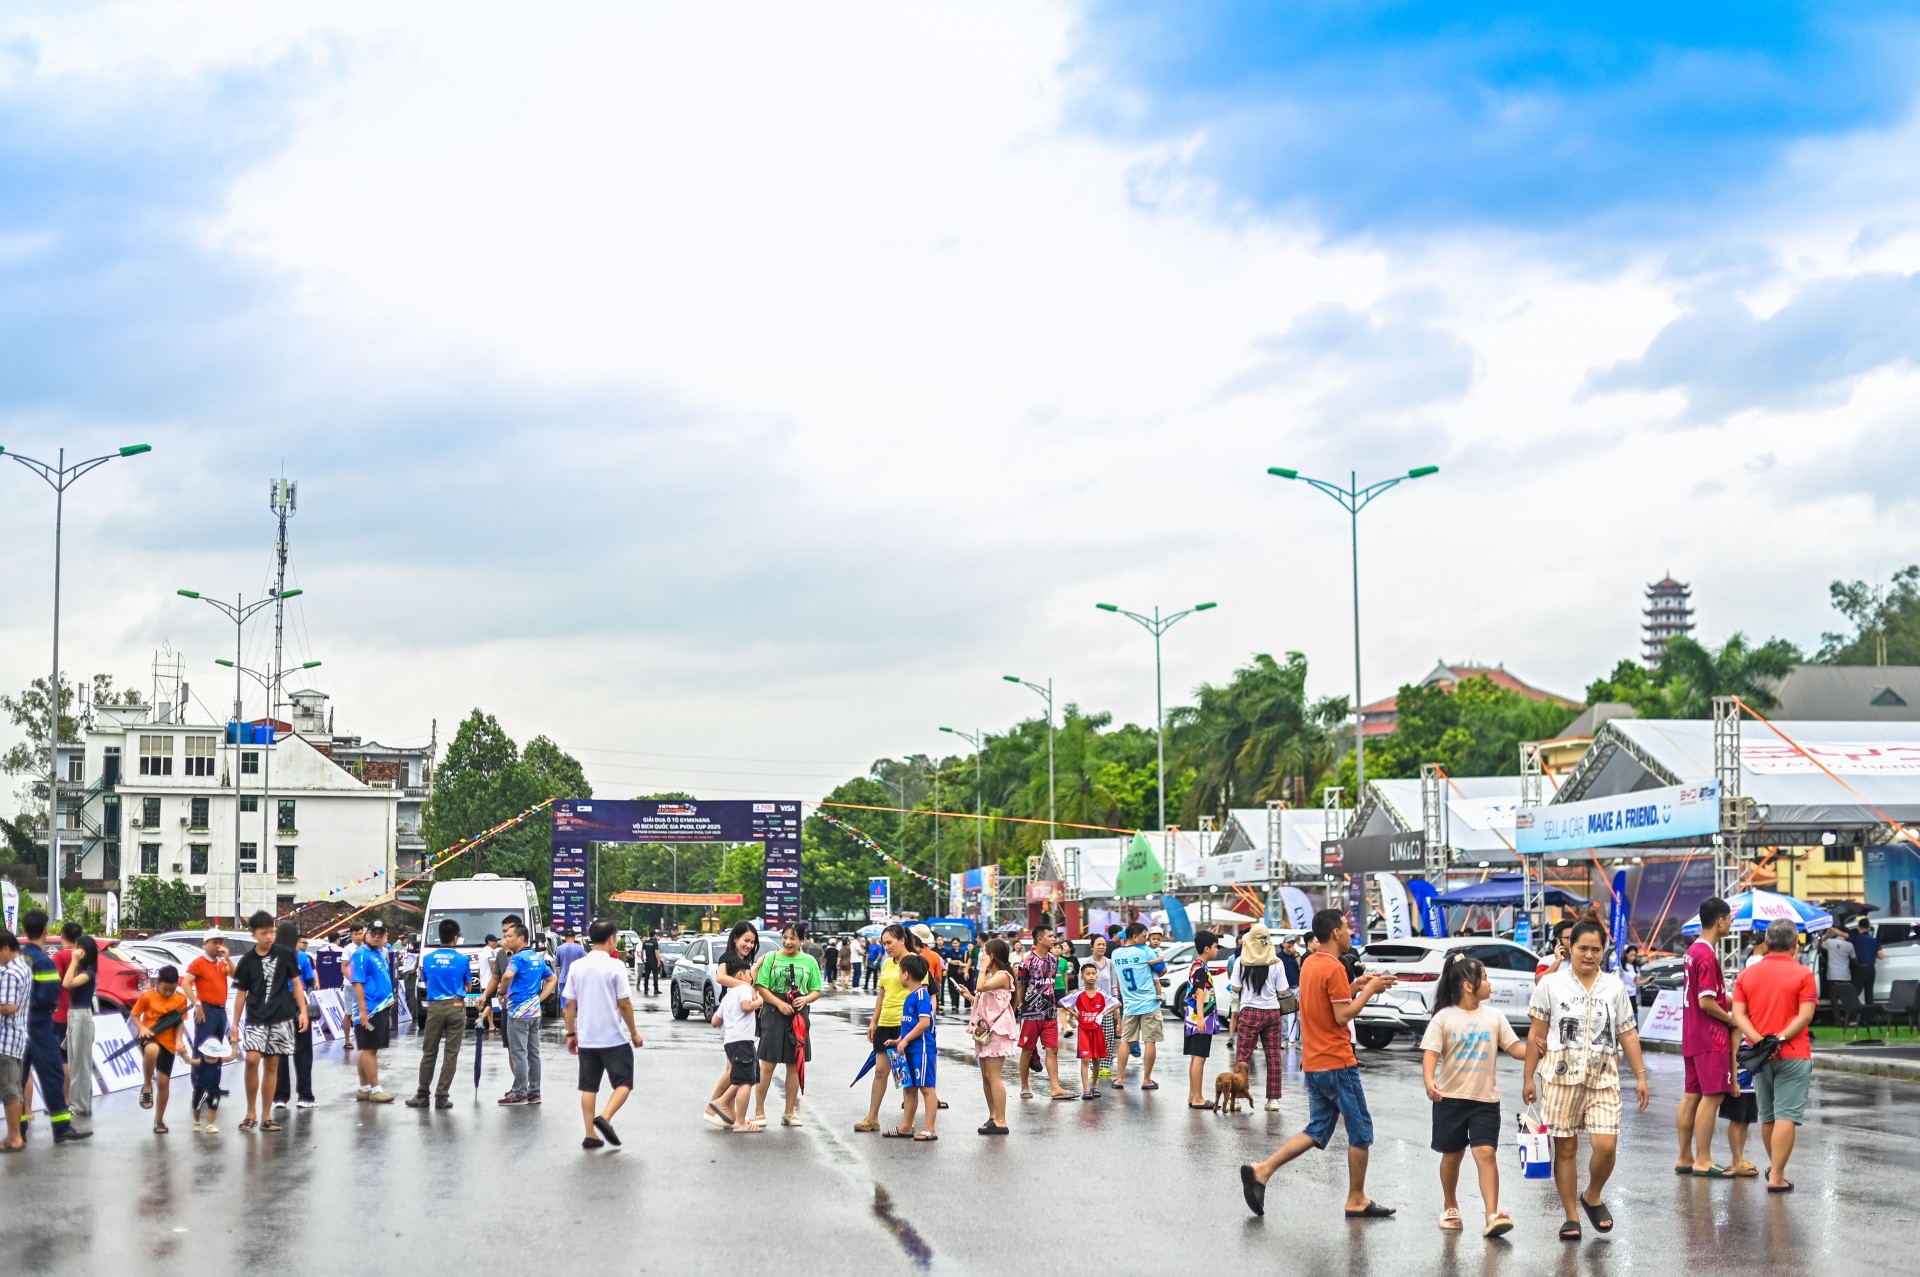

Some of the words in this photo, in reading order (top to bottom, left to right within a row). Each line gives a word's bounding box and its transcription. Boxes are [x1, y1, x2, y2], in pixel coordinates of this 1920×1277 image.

[1680, 789, 1697, 801] BYD
[1544, 820, 1560, 841] SELL
[1561, 820, 1567, 838] A
[1569, 816, 1585, 839] CAR,
[1588, 810, 1614, 834] MAKE
[1615, 811, 1623, 832] A
[1625, 804, 1659, 829] FRIEND.
[1760, 904, 1792, 918] Wells
[1121, 957, 1129, 965] 26
[1133, 956, 1140, 964] 12
[1122, 967, 1138, 992] 9
[1570, 994, 1604, 1008] PARIS
[96, 1038, 141, 1078] VISA
